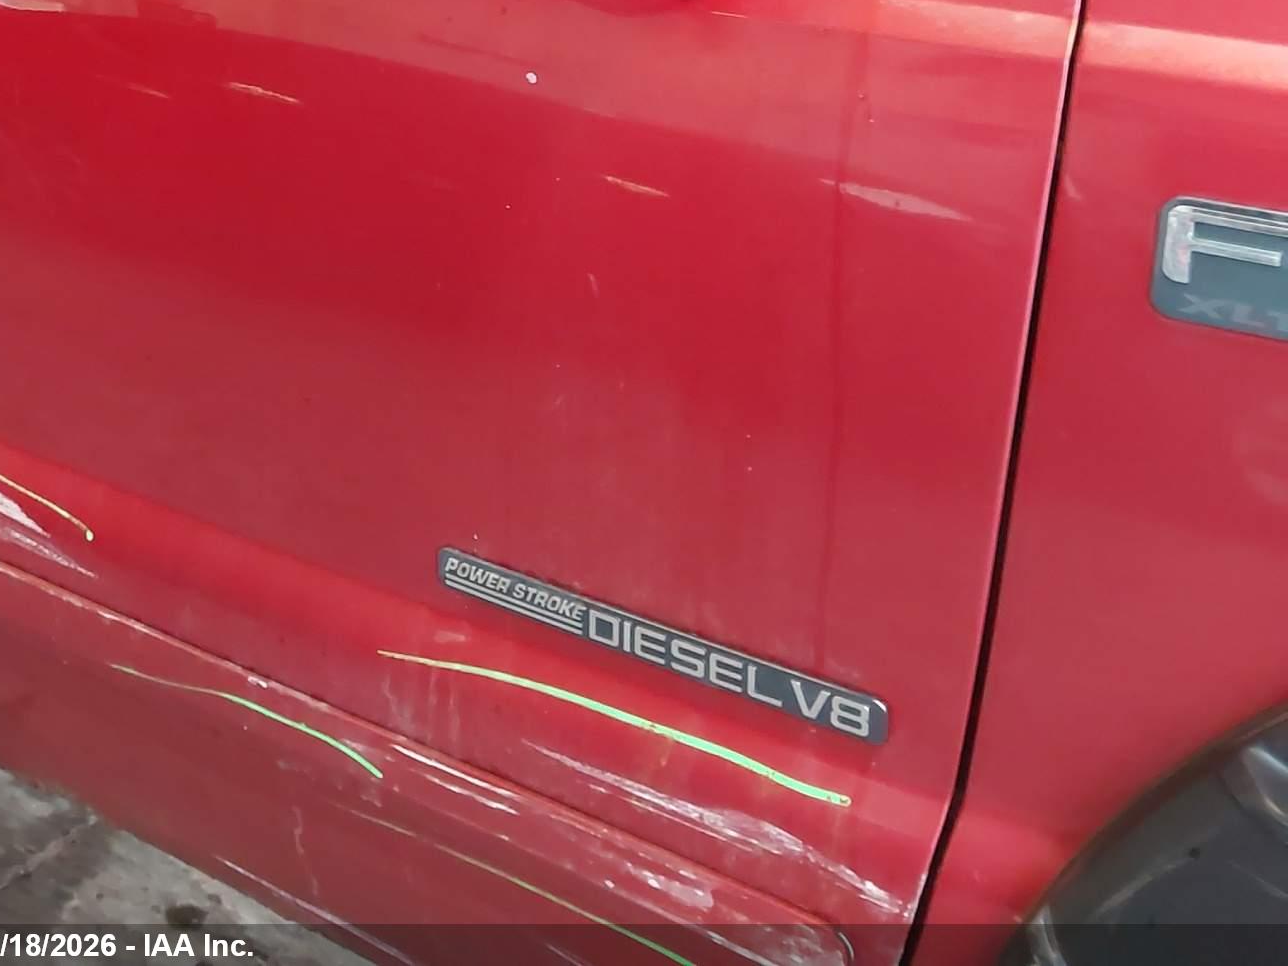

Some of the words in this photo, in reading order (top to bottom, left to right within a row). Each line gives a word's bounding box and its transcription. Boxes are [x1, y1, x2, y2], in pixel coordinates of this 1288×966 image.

[444, 557, 511, 594] POWER
[513, 583, 587, 622] STROKE
[588, 609, 783, 708] DIESEL
[790, 679, 881, 738] V8
